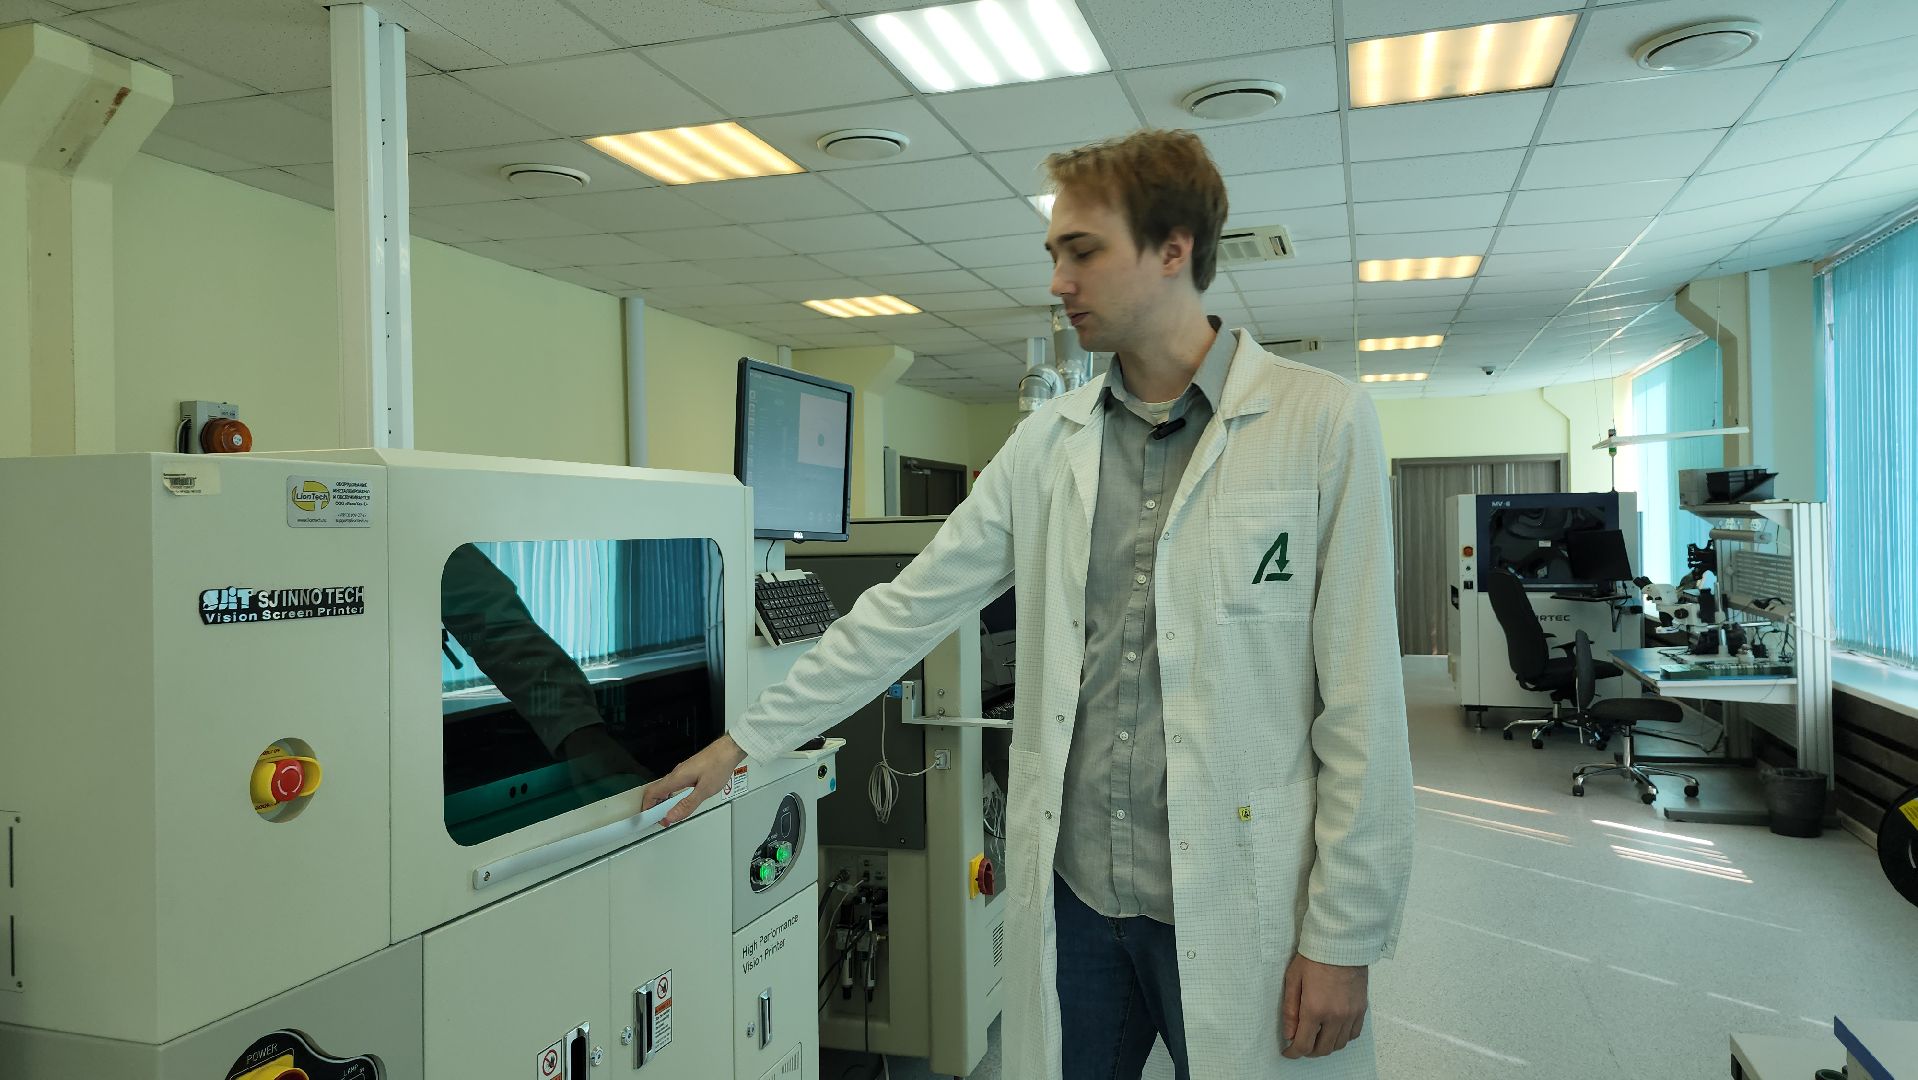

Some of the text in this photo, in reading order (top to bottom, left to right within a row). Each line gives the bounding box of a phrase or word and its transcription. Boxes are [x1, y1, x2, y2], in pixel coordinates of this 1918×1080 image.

[296, 492, 328, 501] LionTech
[325, 586, 365, 604] TECH
[205, 606, 364, 624] Vision Screen Printer
[742, 914, 799, 959] High Performance
[742, 938, 786, 974] Vision Printer
[246, 1043, 278, 1065] POWER
